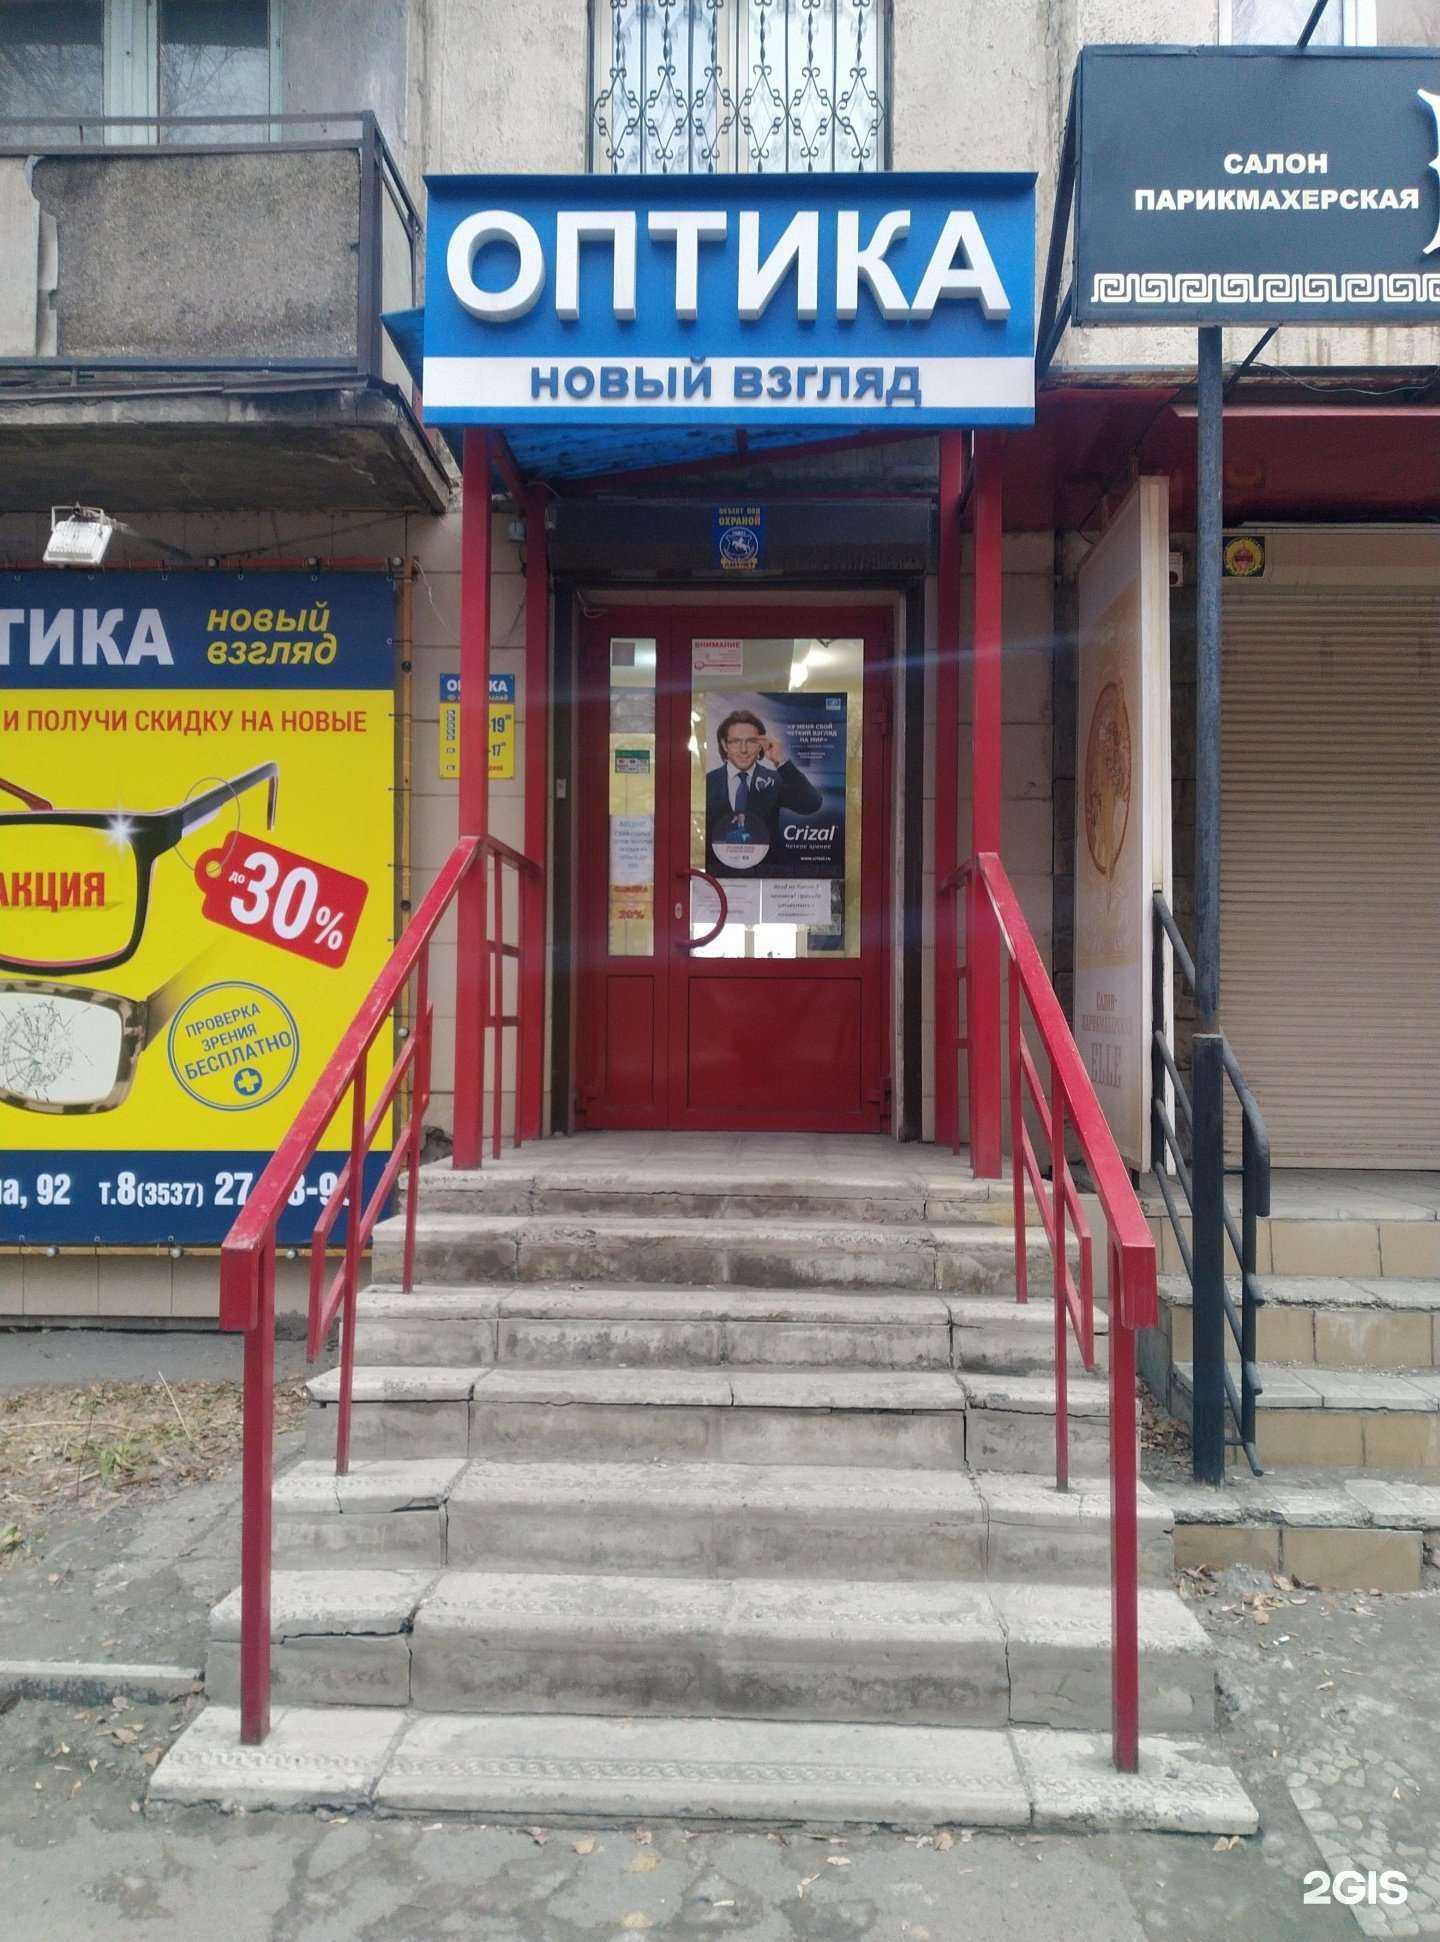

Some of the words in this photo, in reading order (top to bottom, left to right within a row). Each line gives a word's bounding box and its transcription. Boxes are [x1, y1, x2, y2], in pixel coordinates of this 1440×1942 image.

[1224, 153, 1328, 174] САЛОН
[1135, 189, 1419, 210] ПАРИКМАХЕРСКАЯ
[446, 209, 1012, 322] ОПТИКА
[207, 601, 331, 632] новый
[207, 633, 337, 665] взгляд
[3, 710, 19, 731] И
[27, 710, 128, 732] ПОЛУЧИ
[135, 710, 233, 736] СКИДКУ
[241, 711, 273, 732] НА
[281, 711, 367, 732] НОВЫЕ
[783, 825, 835, 840] Crizal
[229, 871, 245, 884] до
[230, 851, 344, 951] 30%
[185, 1003, 261, 1038] ПРОВЕРКА
[202, 1023, 257, 1051] ЗРЕНИЯ
[185, 1031, 291, 1080] БЕСПЛАТНО
[0, 1179, 28, 1209] а,
[36, 1173, 71, 1206] 92
